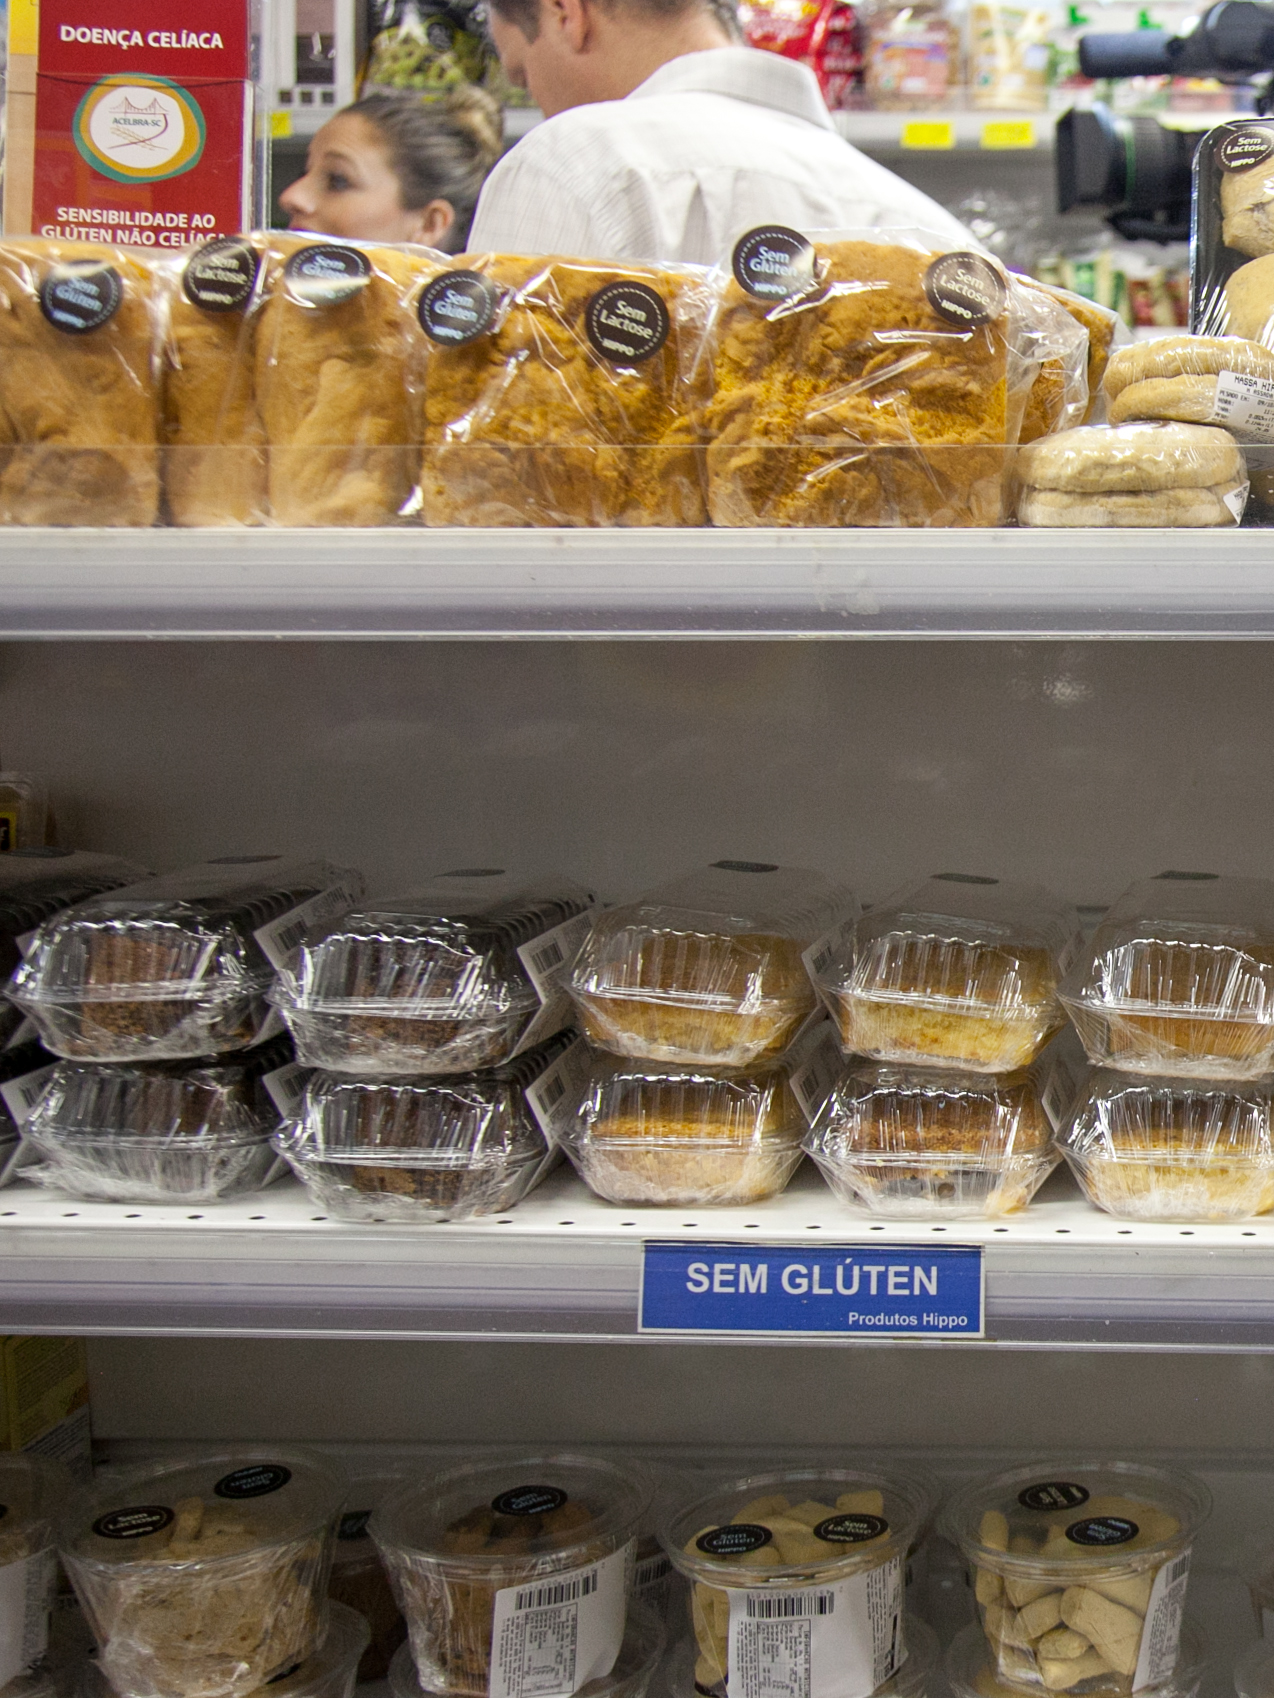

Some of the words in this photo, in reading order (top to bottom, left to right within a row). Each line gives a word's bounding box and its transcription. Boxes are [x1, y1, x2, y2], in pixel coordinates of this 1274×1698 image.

[60, 25, 144, 50] DOENÇA
[148, 30, 223, 49] CELÍACA
[112, 117, 162, 128] ACELBRA-SC
[1226, 143, 1268, 155] Lactose
[1237, 136, 1262, 146] Sem
[1230, 156, 1256, 168] HIPPO
[57, 207, 187, 228] SENSIBILIDADE
[191, 213, 216, 229] AO
[41, 224, 112, 243] GLÚTEN
[116, 228, 155, 246] NÃO
[209, 256, 240, 271] Sem
[314, 254, 346, 271] Sem
[758, 245, 790, 264] Sem
[196, 264, 248, 284] Lactose
[749, 257, 798, 277] Glúten
[67, 276, 100, 297] Sem
[955, 268, 984, 290] Sem
[56, 285, 102, 312] Glúten
[444, 289, 474, 308] Sem
[940, 274, 990, 306] Lactose
[434, 300, 478, 322] Glúten
[614, 300, 647, 322] Sem
[941, 299, 972, 320] HIPPO
[600, 308, 654, 340] Lactose
[602, 338, 636, 356] HIPPO
[1234, 375, 1258, 388] MASSA
[685, 1262, 768, 1294] SEM
[781, 1257, 938, 1296] GLÚTEN
[848, 1312, 918, 1326] Produtos
[922, 1312, 968, 1328] Hippo
[108, 1515, 160, 1530] Lactose
[828, 1524, 872, 1535] Lactose
[843, 1520, 868, 1528] Sem
[712, 1536, 755, 1546] Glúten
[720, 1532, 747, 1540] Sem
